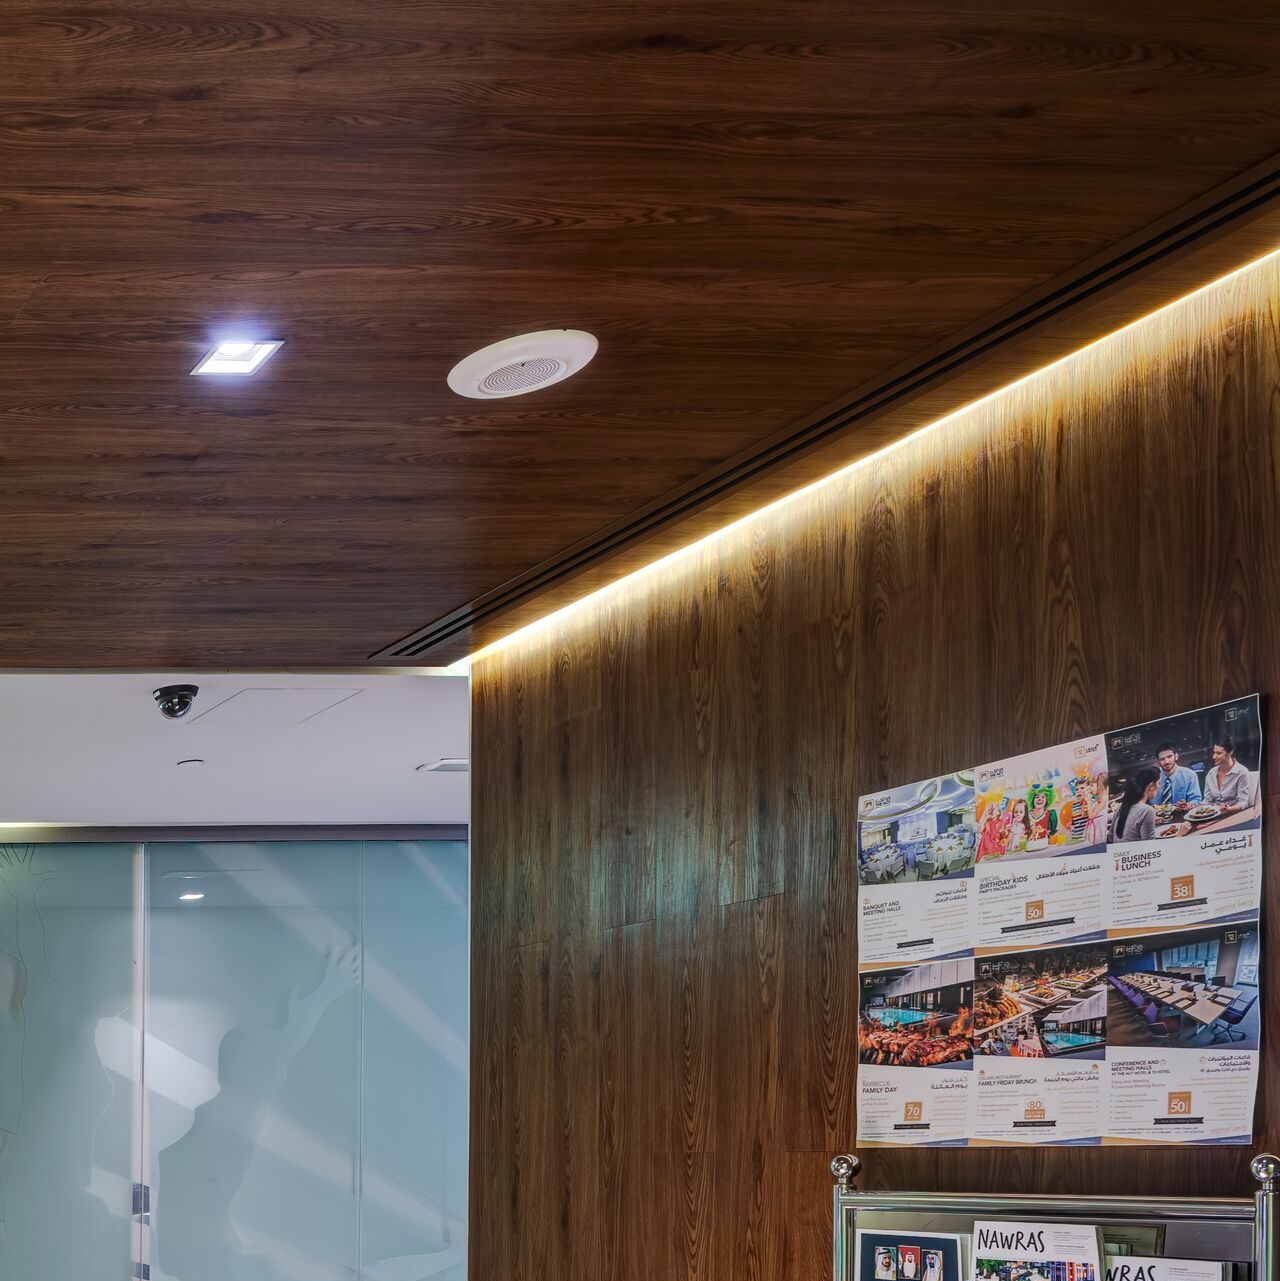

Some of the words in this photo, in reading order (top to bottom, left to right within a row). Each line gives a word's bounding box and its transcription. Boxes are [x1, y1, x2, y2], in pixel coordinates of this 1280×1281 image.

[1121, 850, 1162, 864] BUSINESS
[1121, 860, 1151, 872] LUNCH
[980, 879, 1011, 890] BIRTHDAY
[1012, 876, 1028, 884] KIDS
[1173, 886, 1188, 898] 38
[863, 908, 885, 916] MEETING
[1027, 909, 1040, 919] 50
[1029, 1101, 1041, 1109] 80
[1170, 1102, 1185, 1112] 50
[907, 1107, 920, 1116] 70
[978, 1229, 1045, 1253] NAWRAS
